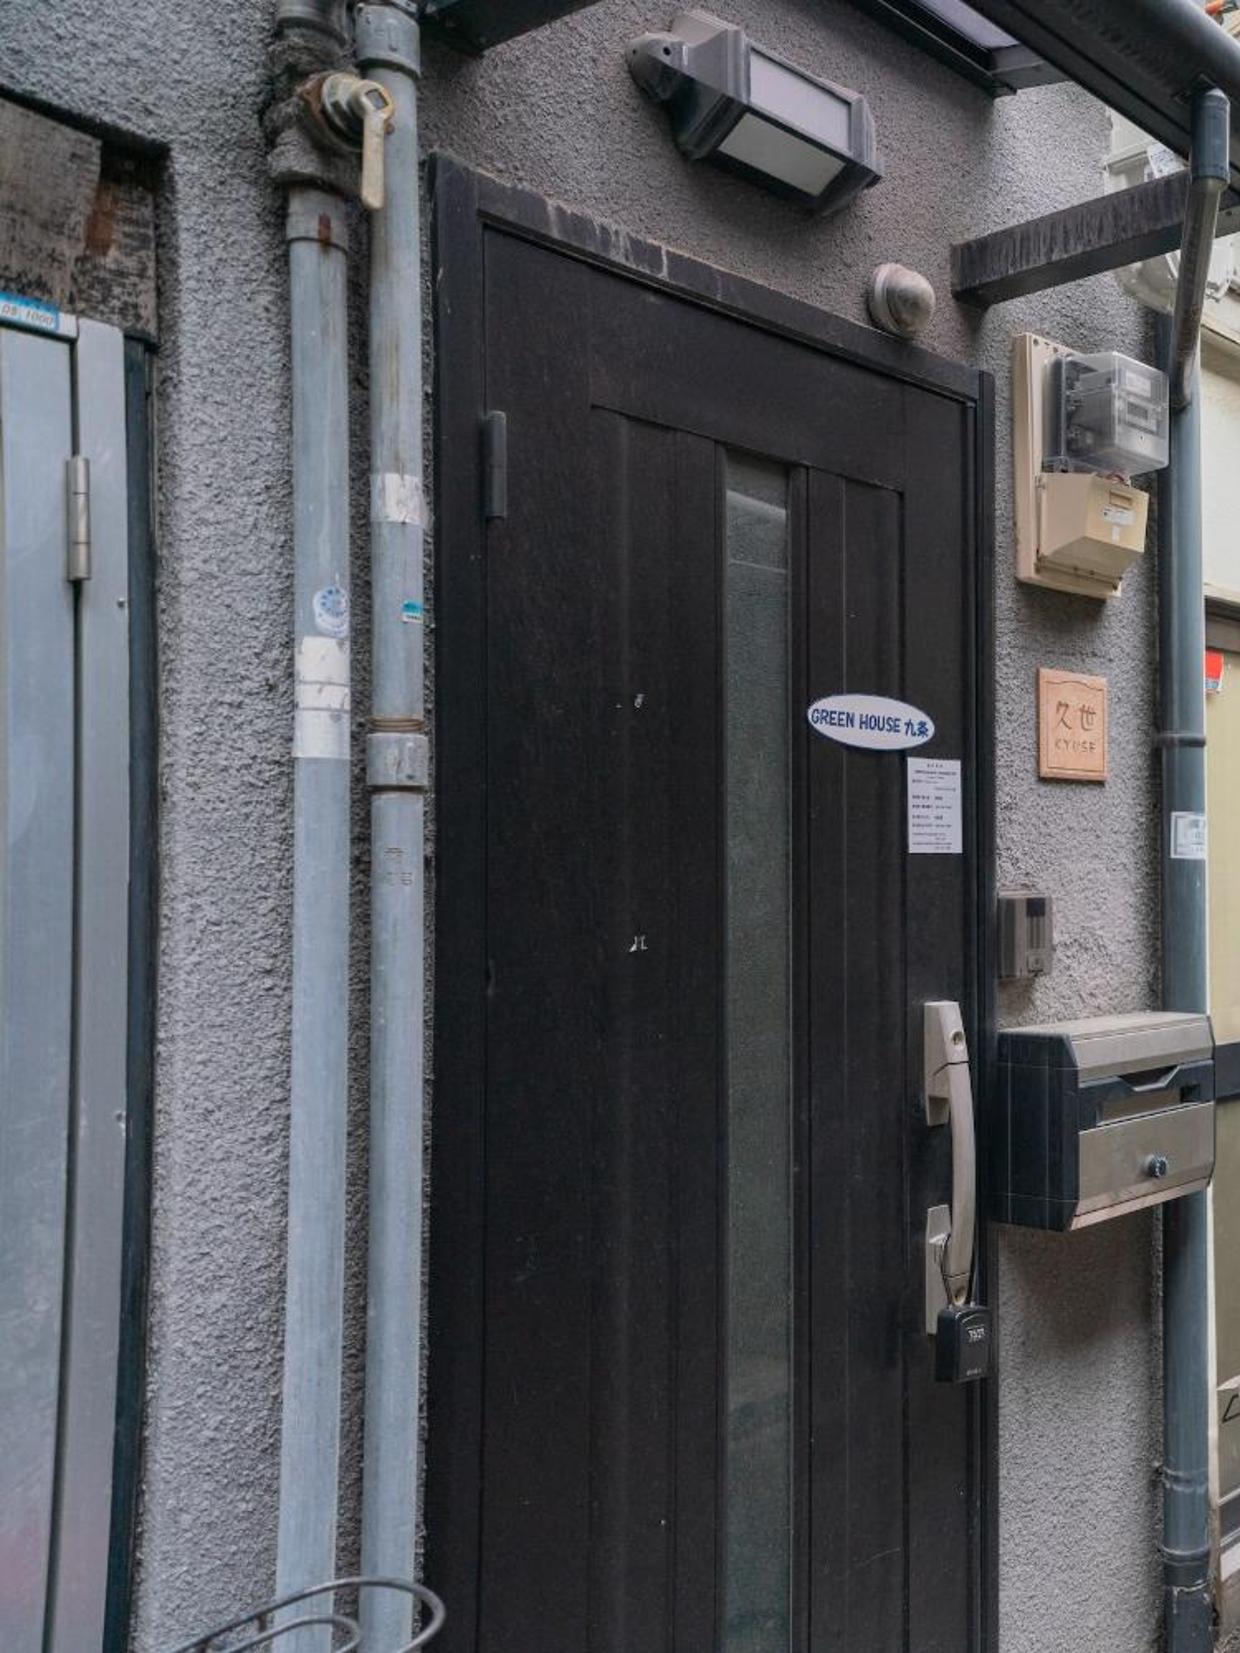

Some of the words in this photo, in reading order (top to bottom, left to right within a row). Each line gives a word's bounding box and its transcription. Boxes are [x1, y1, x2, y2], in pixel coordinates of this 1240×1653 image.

[811, 708, 856, 728] GREEN
[859, 713, 902, 733] HOUSE
[904, 719, 929, 738] 九条
[1055, 700, 1097, 732] 久世
[1055, 738, 1097, 753] KYUSE
